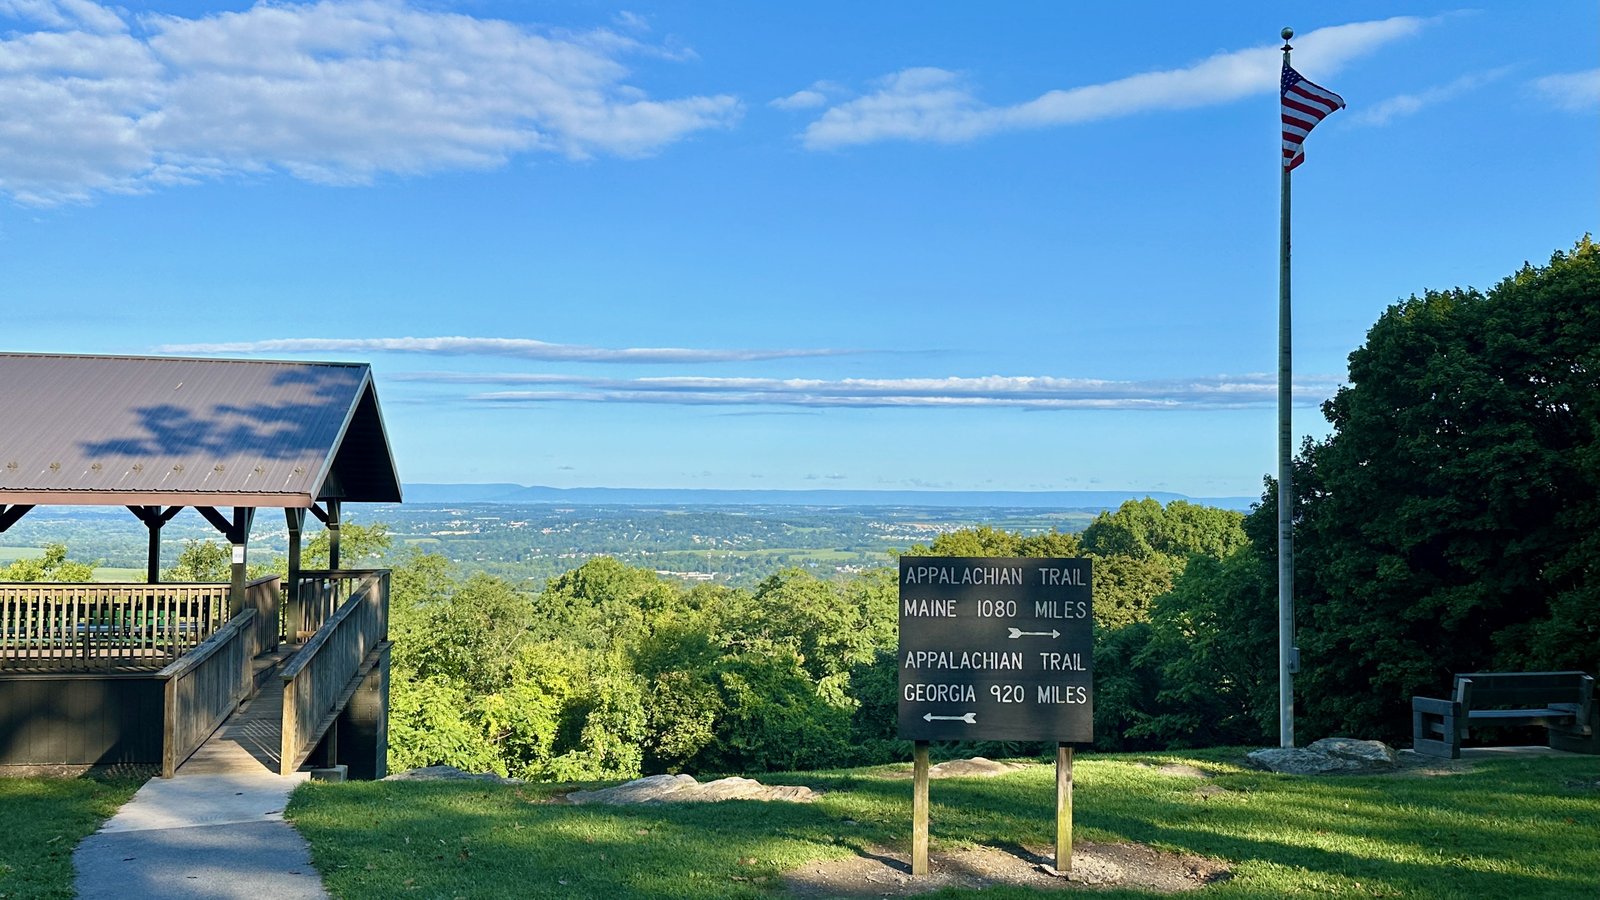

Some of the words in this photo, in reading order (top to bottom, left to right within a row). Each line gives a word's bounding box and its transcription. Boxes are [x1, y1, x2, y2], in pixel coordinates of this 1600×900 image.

[906, 567, 1022, 585] APPALACHIAN
[1039, 568, 1086, 586] TRAIL
[905, 599, 957, 617] MAINE
[977, 600, 1017, 617] 1080
[1035, 601, 1087, 618] MILES
[905, 651, 1023, 669] APPALACHIAN
[1040, 653, 1086, 671] TRAIL
[904, 684, 976, 703] GEORGIA
[990, 685, 1024, 703] 920
[1038, 686, 1087, 704] MILES
